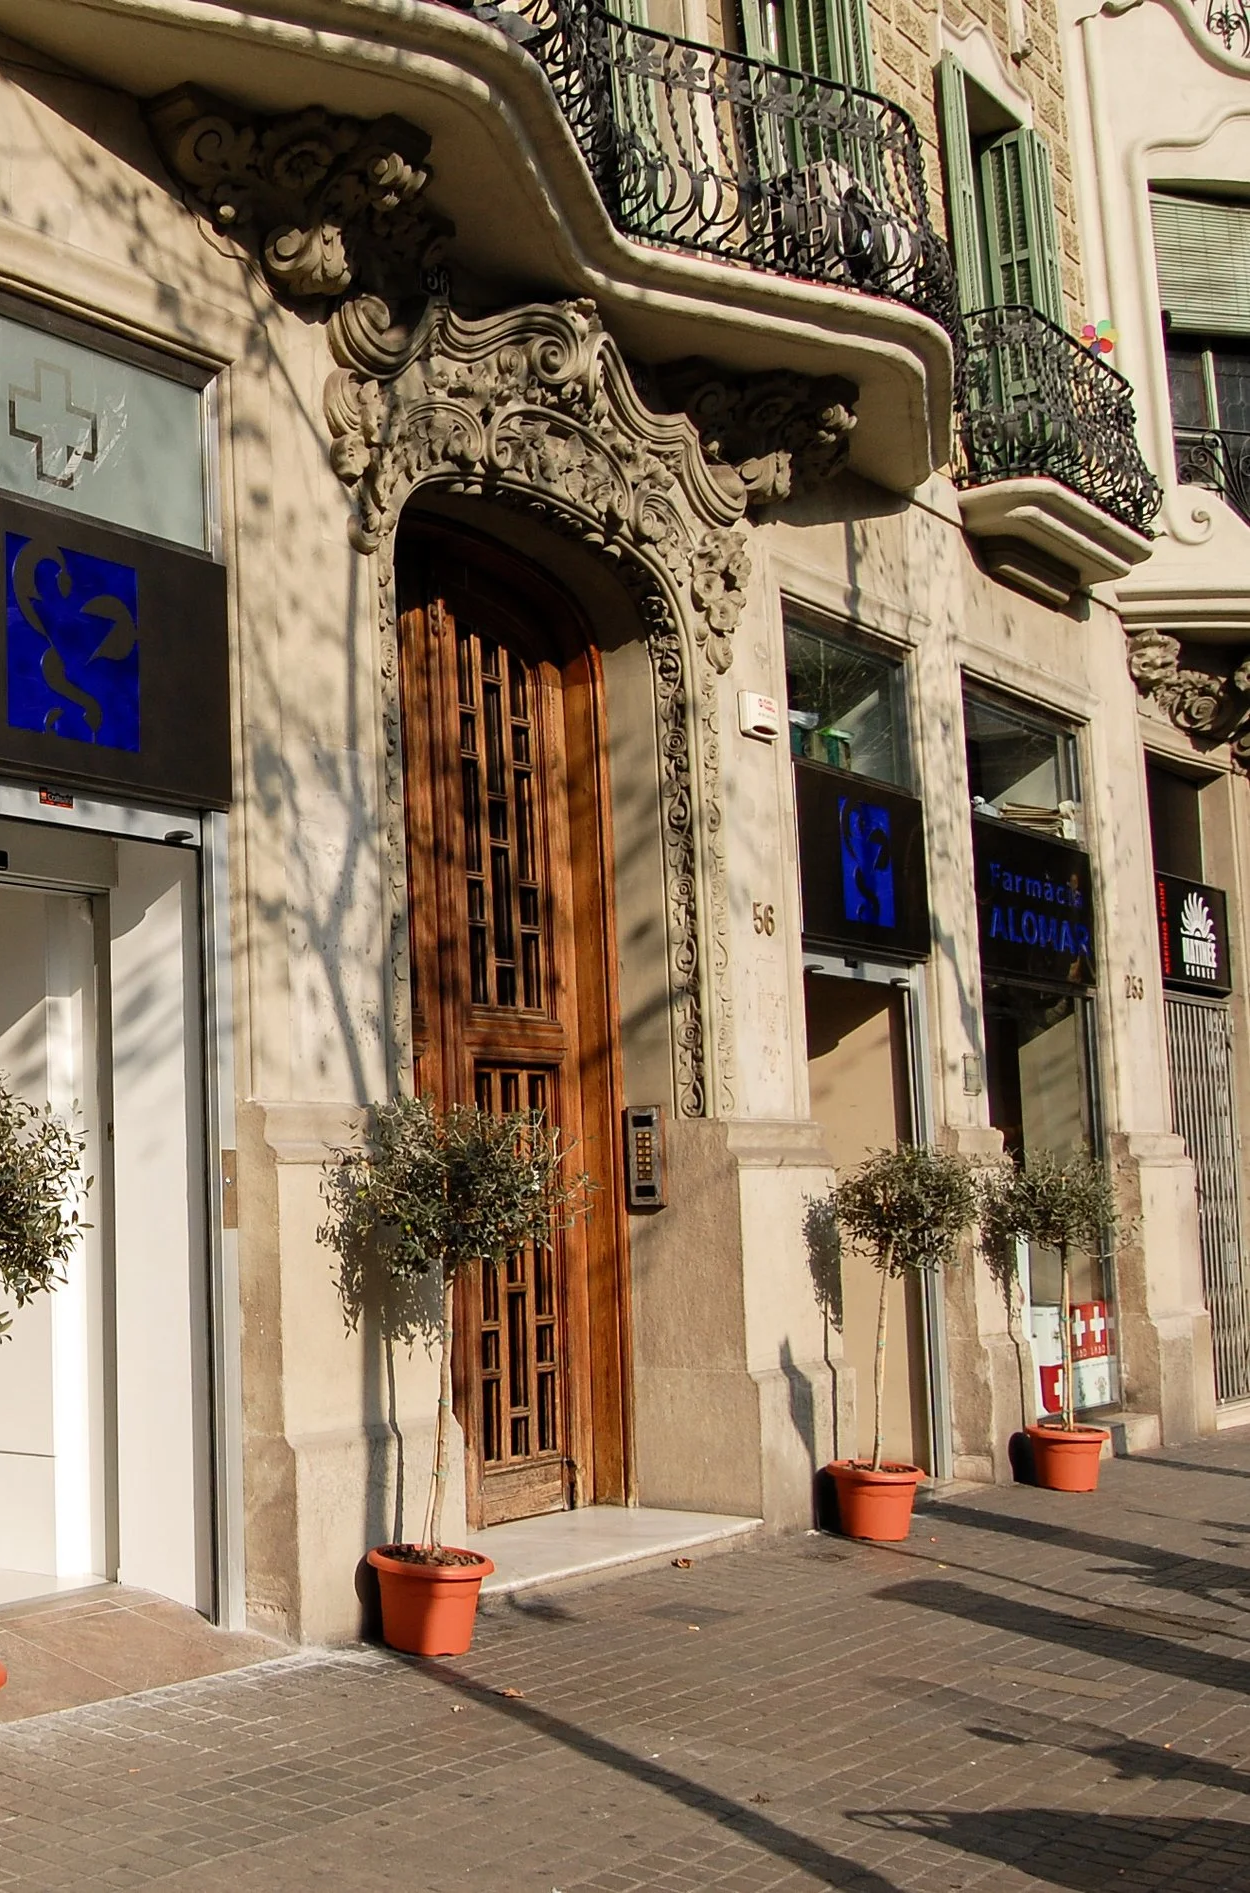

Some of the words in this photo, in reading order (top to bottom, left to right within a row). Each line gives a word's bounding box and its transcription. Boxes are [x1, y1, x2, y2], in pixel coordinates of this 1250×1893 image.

[989, 862, 1084, 908] Farmàcia
[752, 902, 775, 936] 56
[989, 906, 1092, 956] ALOMAR
[1124, 975, 1145, 1000] 253
